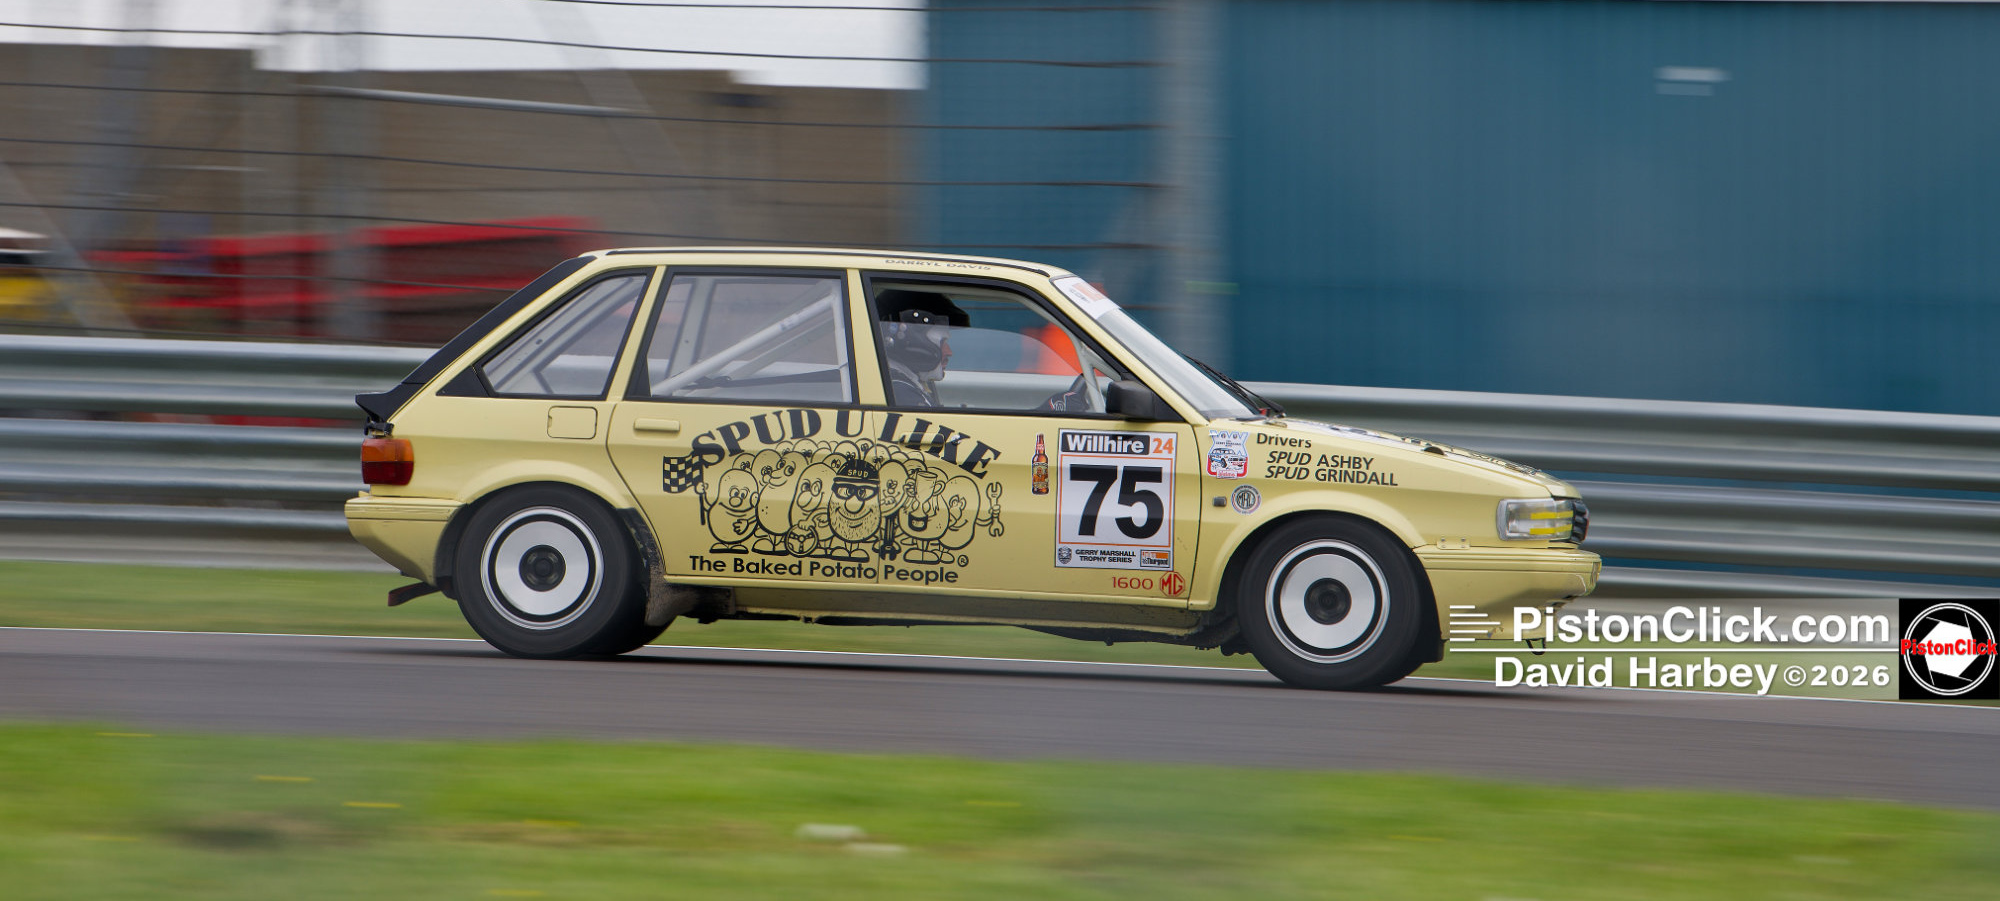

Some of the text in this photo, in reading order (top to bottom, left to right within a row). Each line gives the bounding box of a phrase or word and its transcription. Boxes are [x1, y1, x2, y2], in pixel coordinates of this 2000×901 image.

[946, 262, 992, 270] DAVIS
[691, 409, 1003, 480] SPUD U LIKE
[1067, 434, 1174, 454] Willhire 24
[1256, 432, 1313, 449] Drivers
[1267, 450, 1375, 471] SPUD ASHBY
[847, 469, 869, 478] SPUD
[1265, 465, 1399, 487] SPUD GRINDALL
[1069, 463, 1165, 540] 75
[689, 555, 959, 585] The Baked Potato People
[1112, 572, 1185, 597] 1600 MG
